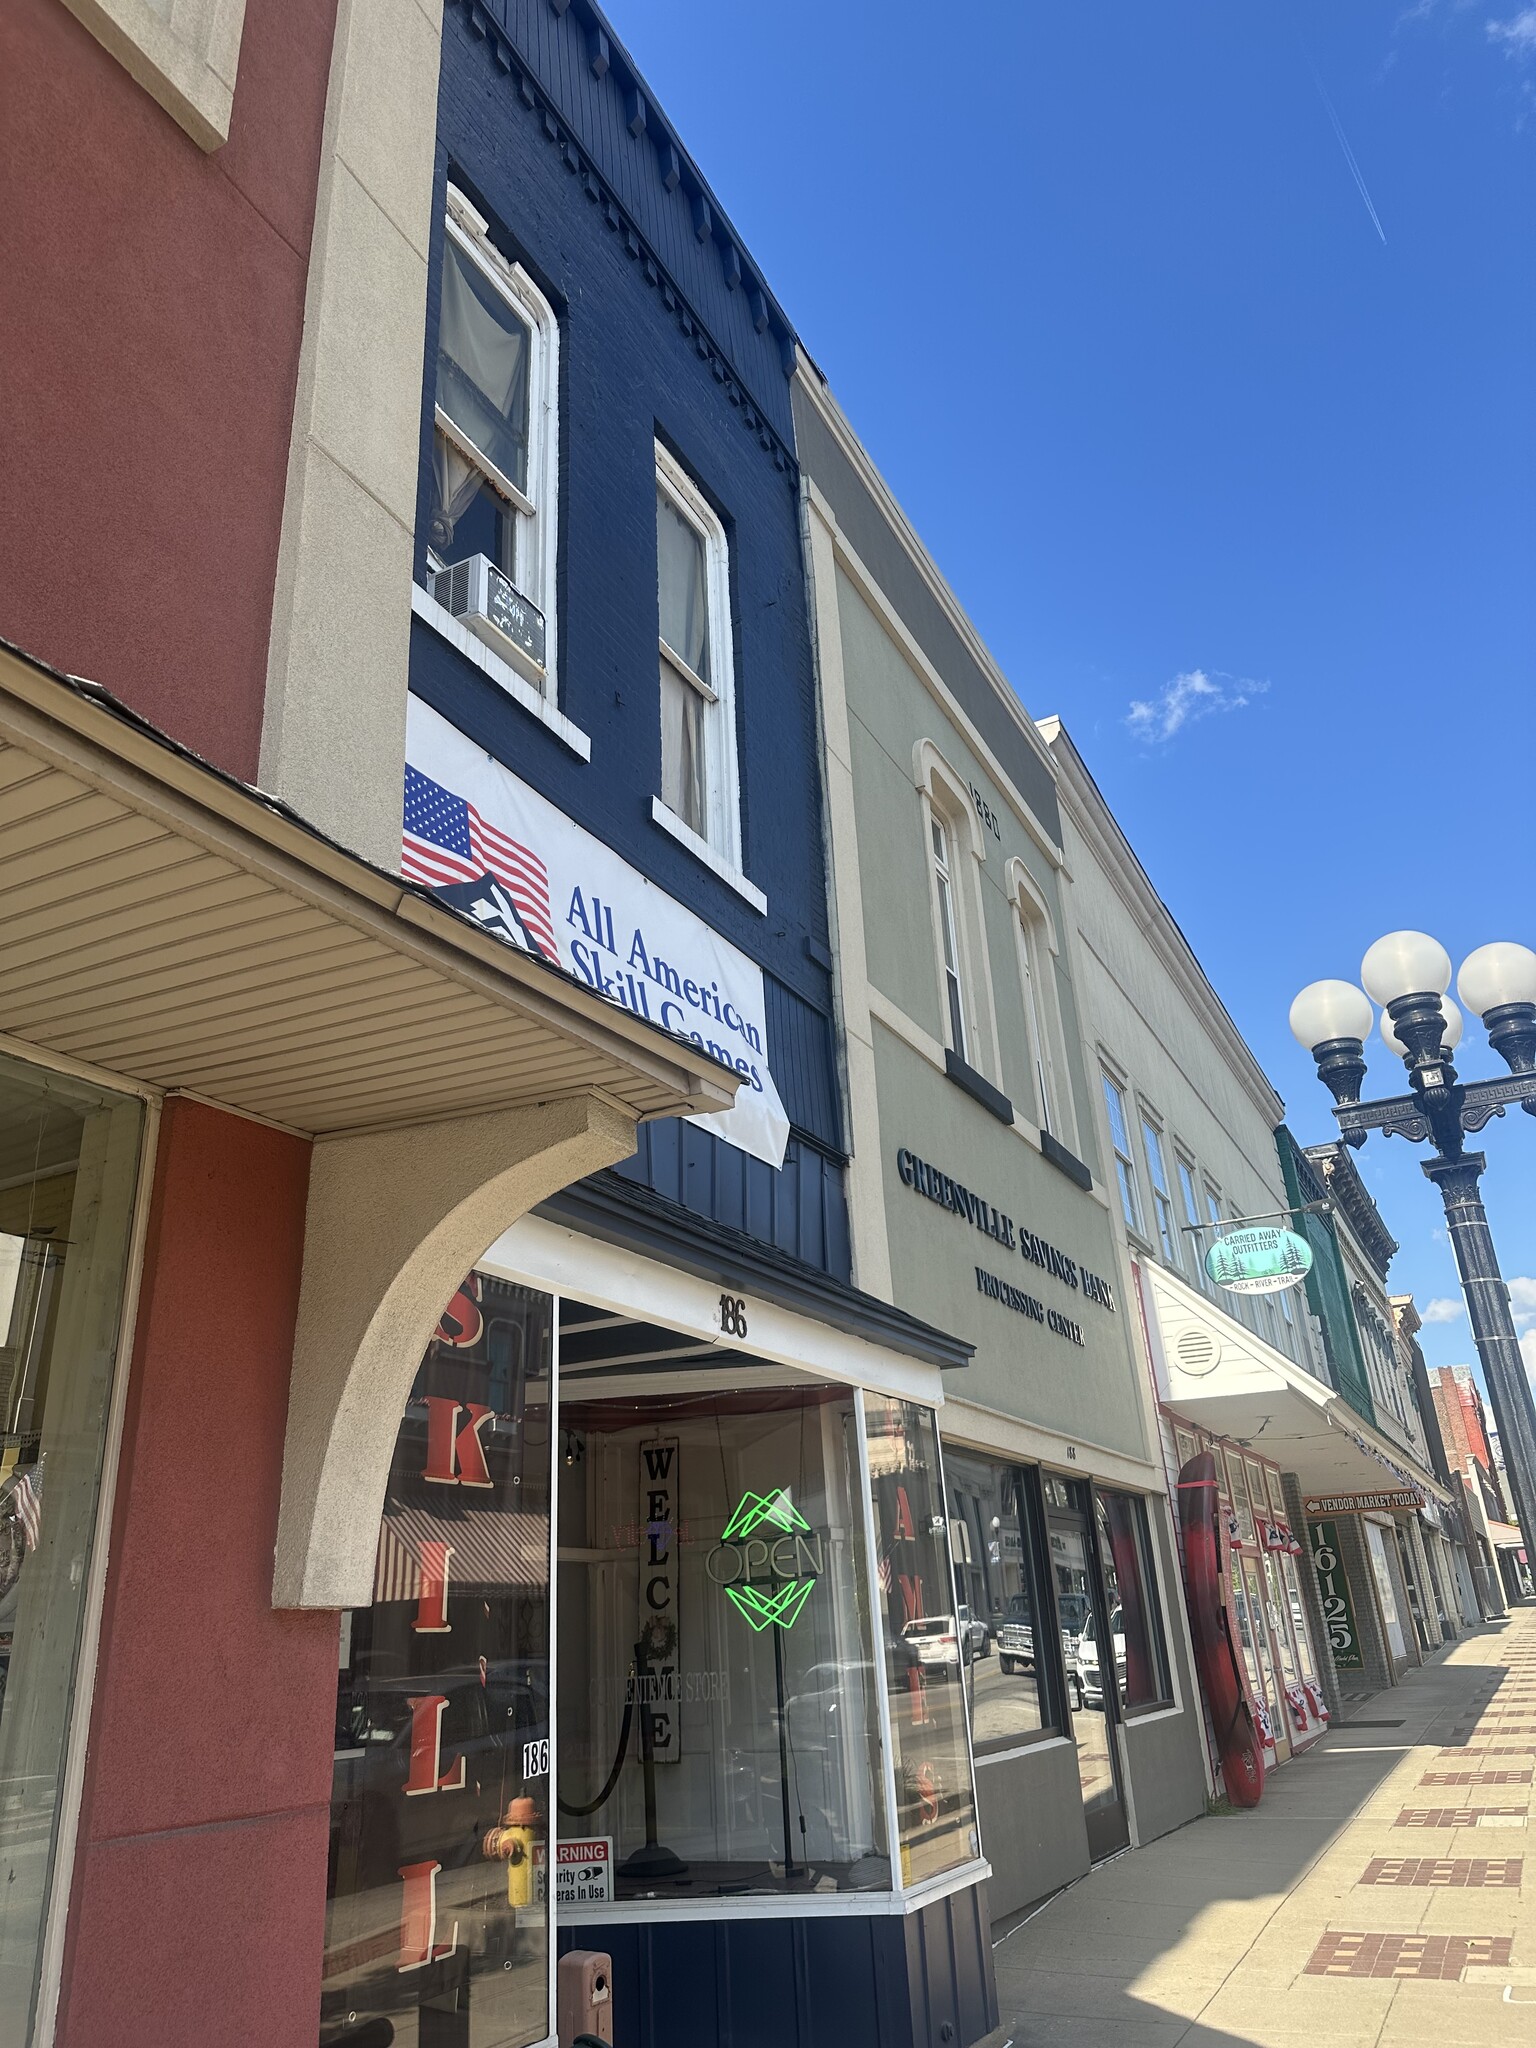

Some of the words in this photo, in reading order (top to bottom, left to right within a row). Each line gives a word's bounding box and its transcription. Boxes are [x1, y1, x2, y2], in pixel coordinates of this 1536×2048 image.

[968, 781, 1001, 842] 1880
[566, 886, 618, 957] All
[627, 929, 763, 1056] American
[570, 940, 651, 1020] Skill
[897, 1148, 1016, 1250] GREENVILLE
[1019, 1227, 1079, 1289] SAVINGS
[1079, 1266, 1116, 1312] BANK
[1224, 1233, 1256, 1246] CARRIED
[1259, 1229, 1281, 1241] AWAY
[1232, 1239, 1277, 1254] OUTFITTERS
[1234, 1281, 1250, 1291] ROCK
[1255, 1279, 1272, 1288] RIVER
[1277, 1275, 1294, 1285] TRAIL
[719, 1293, 748, 1339] 186
[975, 1267, 1044, 1324] PROCESSING
[1047, 1309, 1086, 1346] CENTER
[1321, 1497, 1355, 1512] VENDOR
[1355, 1494, 1391, 1509] MARKET
[1393, 1491, 1420, 1506] TODAY
[705, 1533, 824, 1584] OPEN
[1314, 1523, 1352, 1649] 16125
[685, 1669, 732, 1703] STORE
[523, 1740, 548, 1778] 186
[536, 1845, 605, 1863] WRNING
[577, 1885, 586, 1900] In
[588, 1884, 605, 1899] Use
